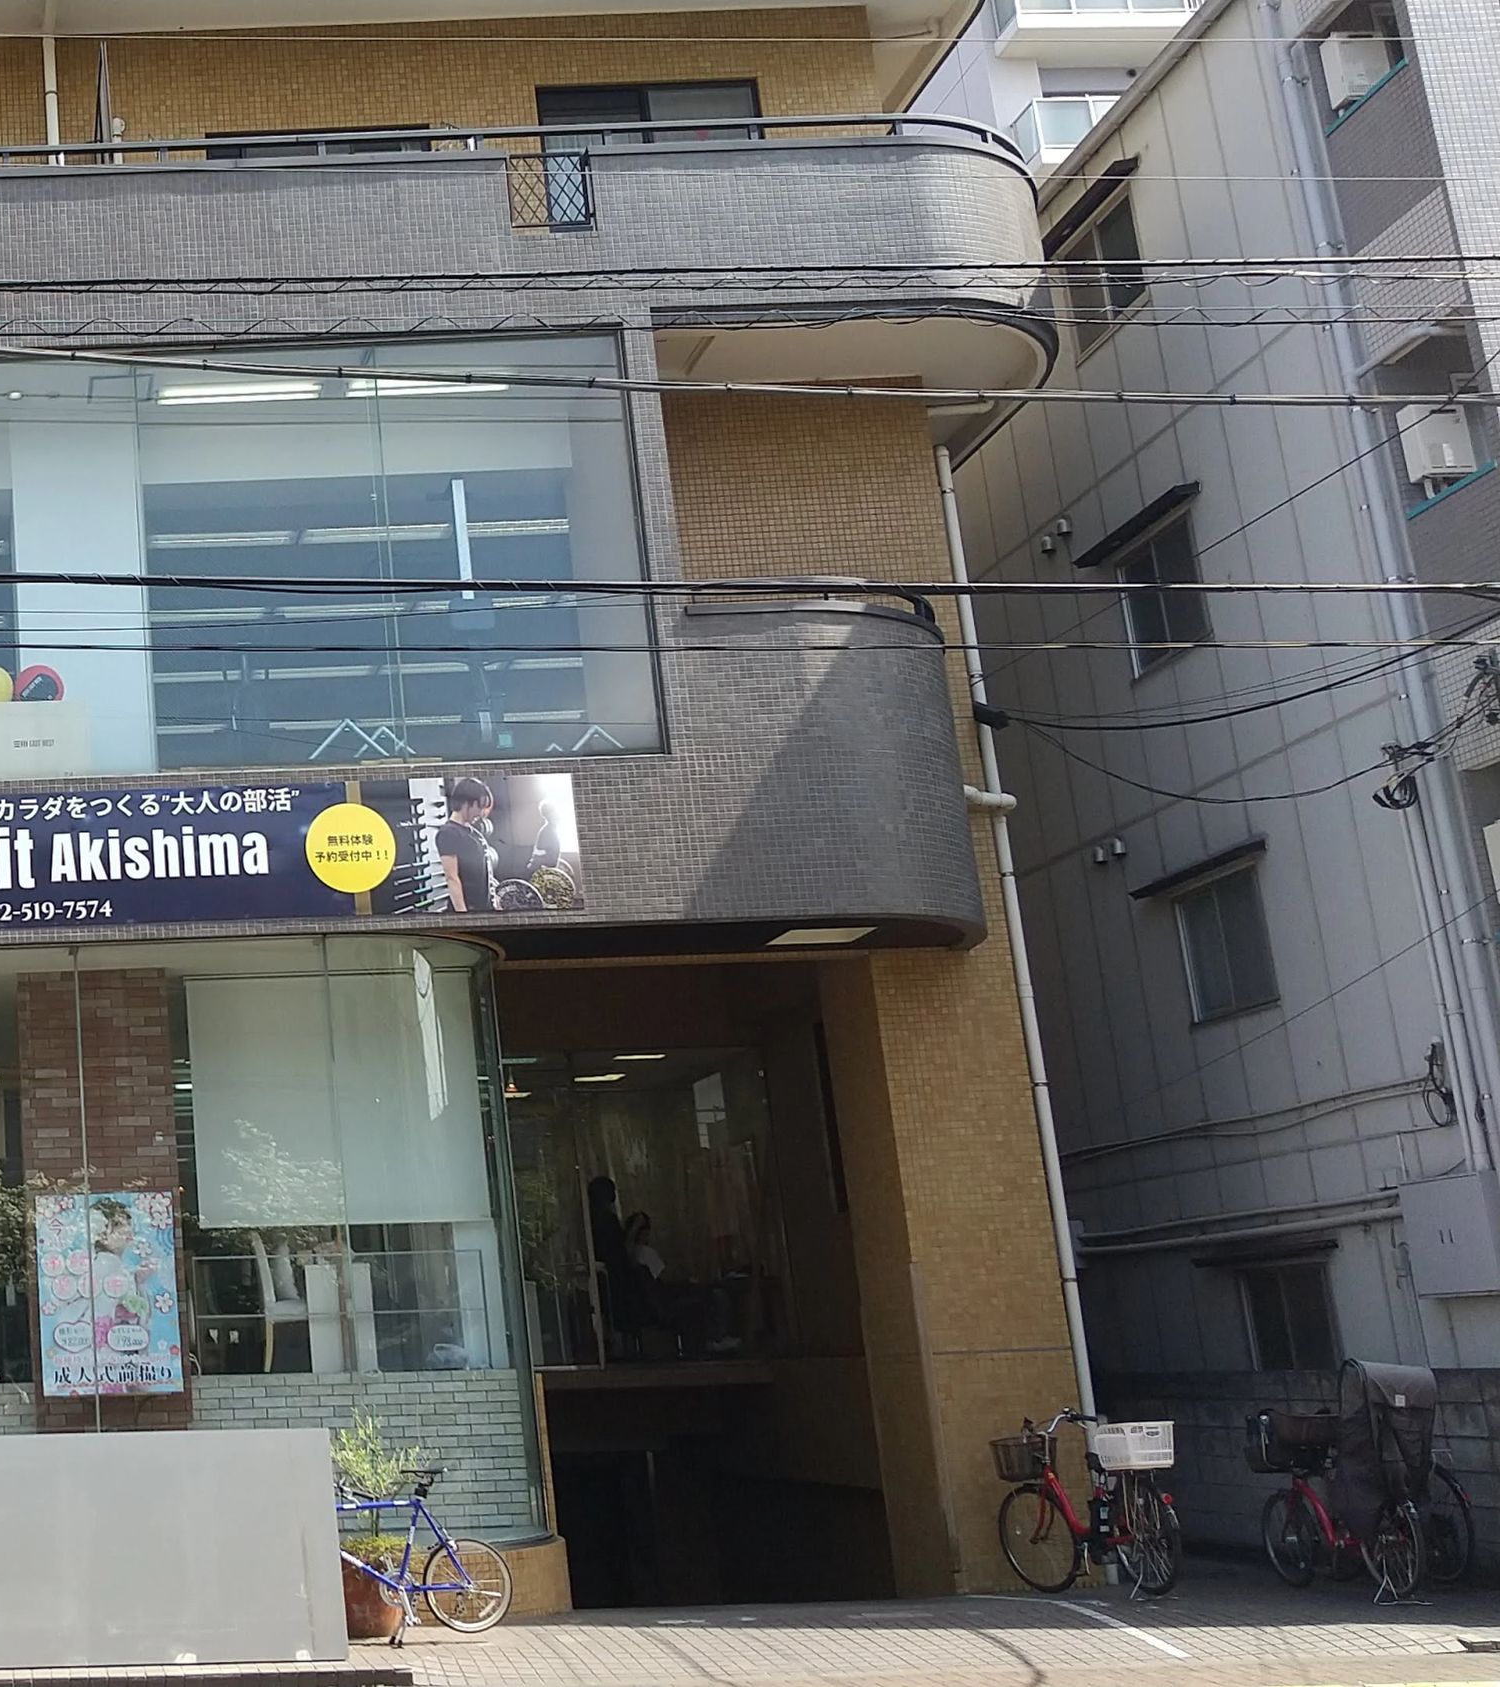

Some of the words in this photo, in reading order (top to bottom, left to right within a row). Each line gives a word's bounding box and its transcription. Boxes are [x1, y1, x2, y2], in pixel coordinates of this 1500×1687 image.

[326, 834, 375, 849] 無料体験
[50, 828, 270, 882] Akishima
[54, 1363, 172, 1384] 成人式前撮り
